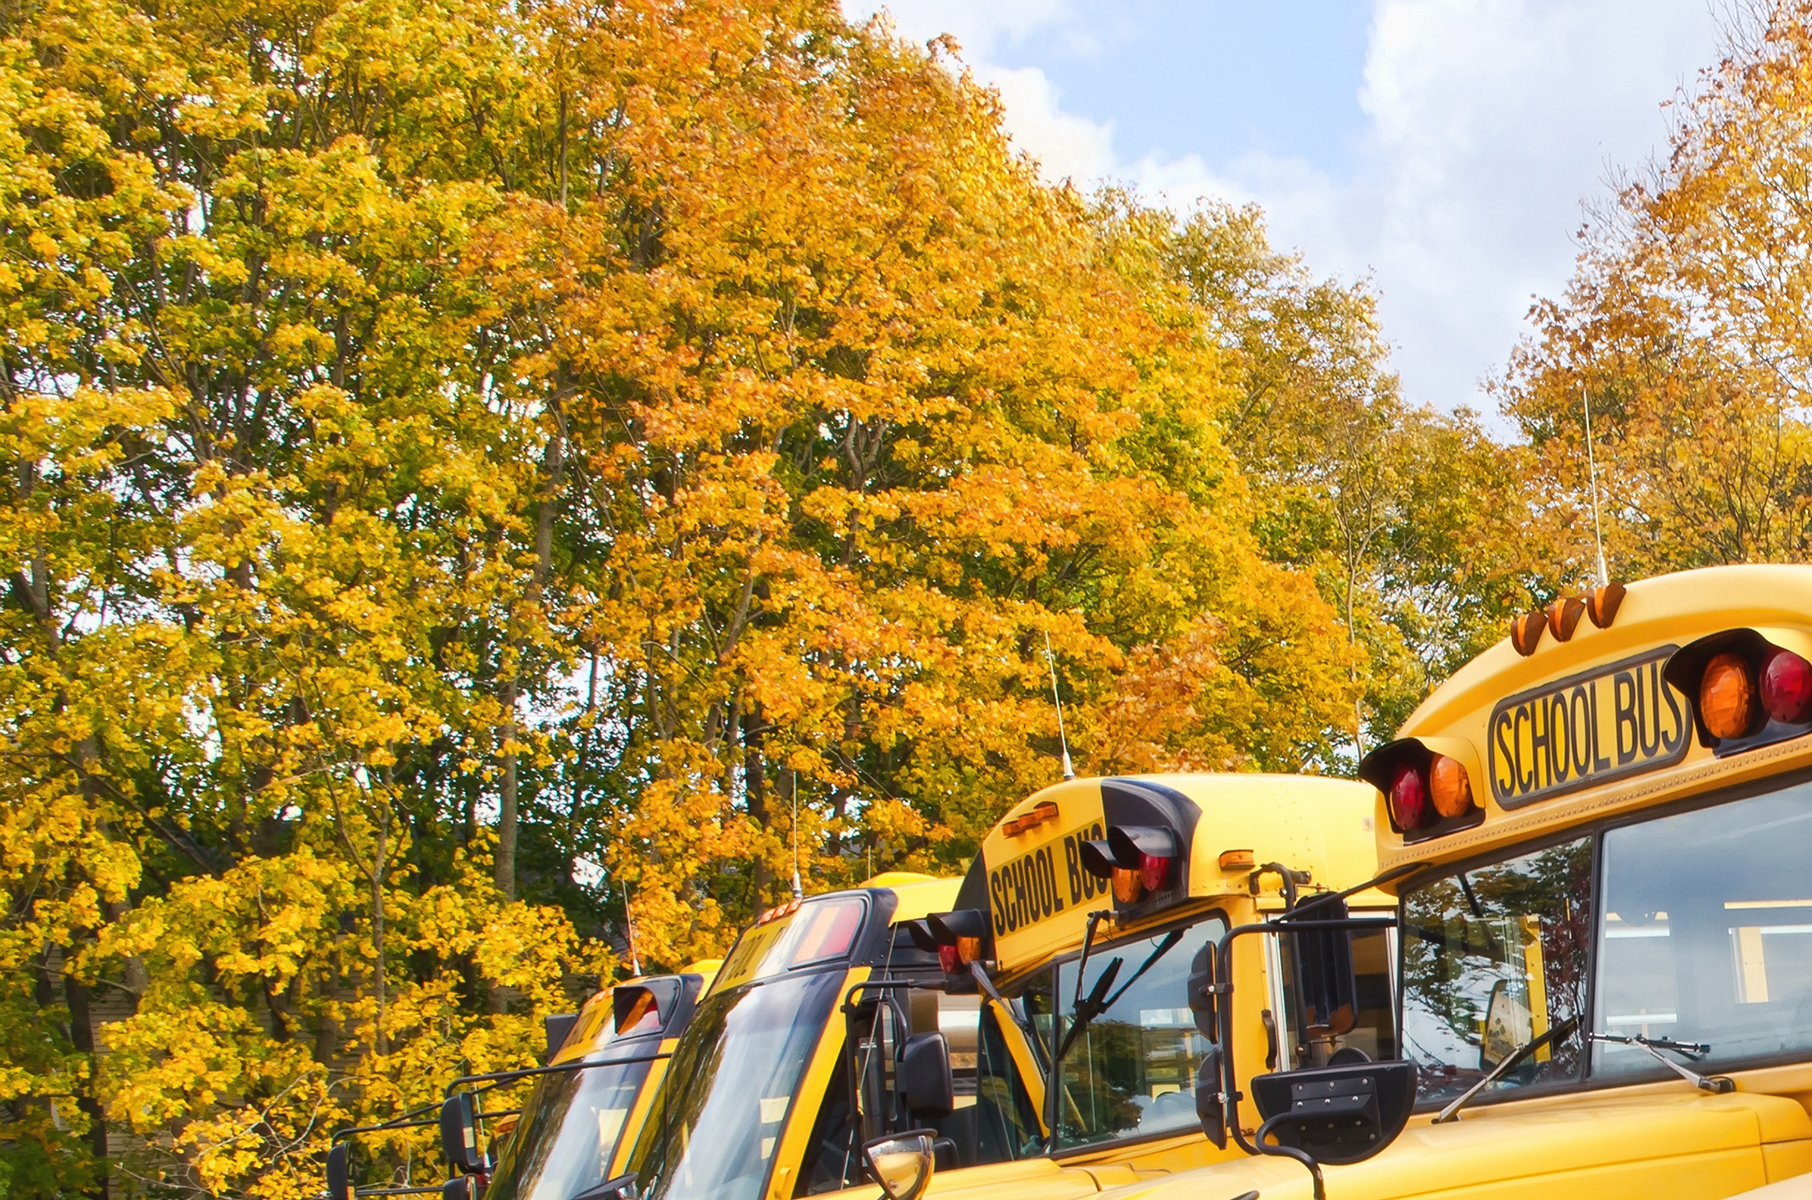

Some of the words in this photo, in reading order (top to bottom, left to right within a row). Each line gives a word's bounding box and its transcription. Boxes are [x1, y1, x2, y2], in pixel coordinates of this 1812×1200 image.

[1496, 681, 1611, 798] SCHOOL
[1613, 661, 1684, 766] BUS
[991, 845, 1065, 938] SCHOOL
